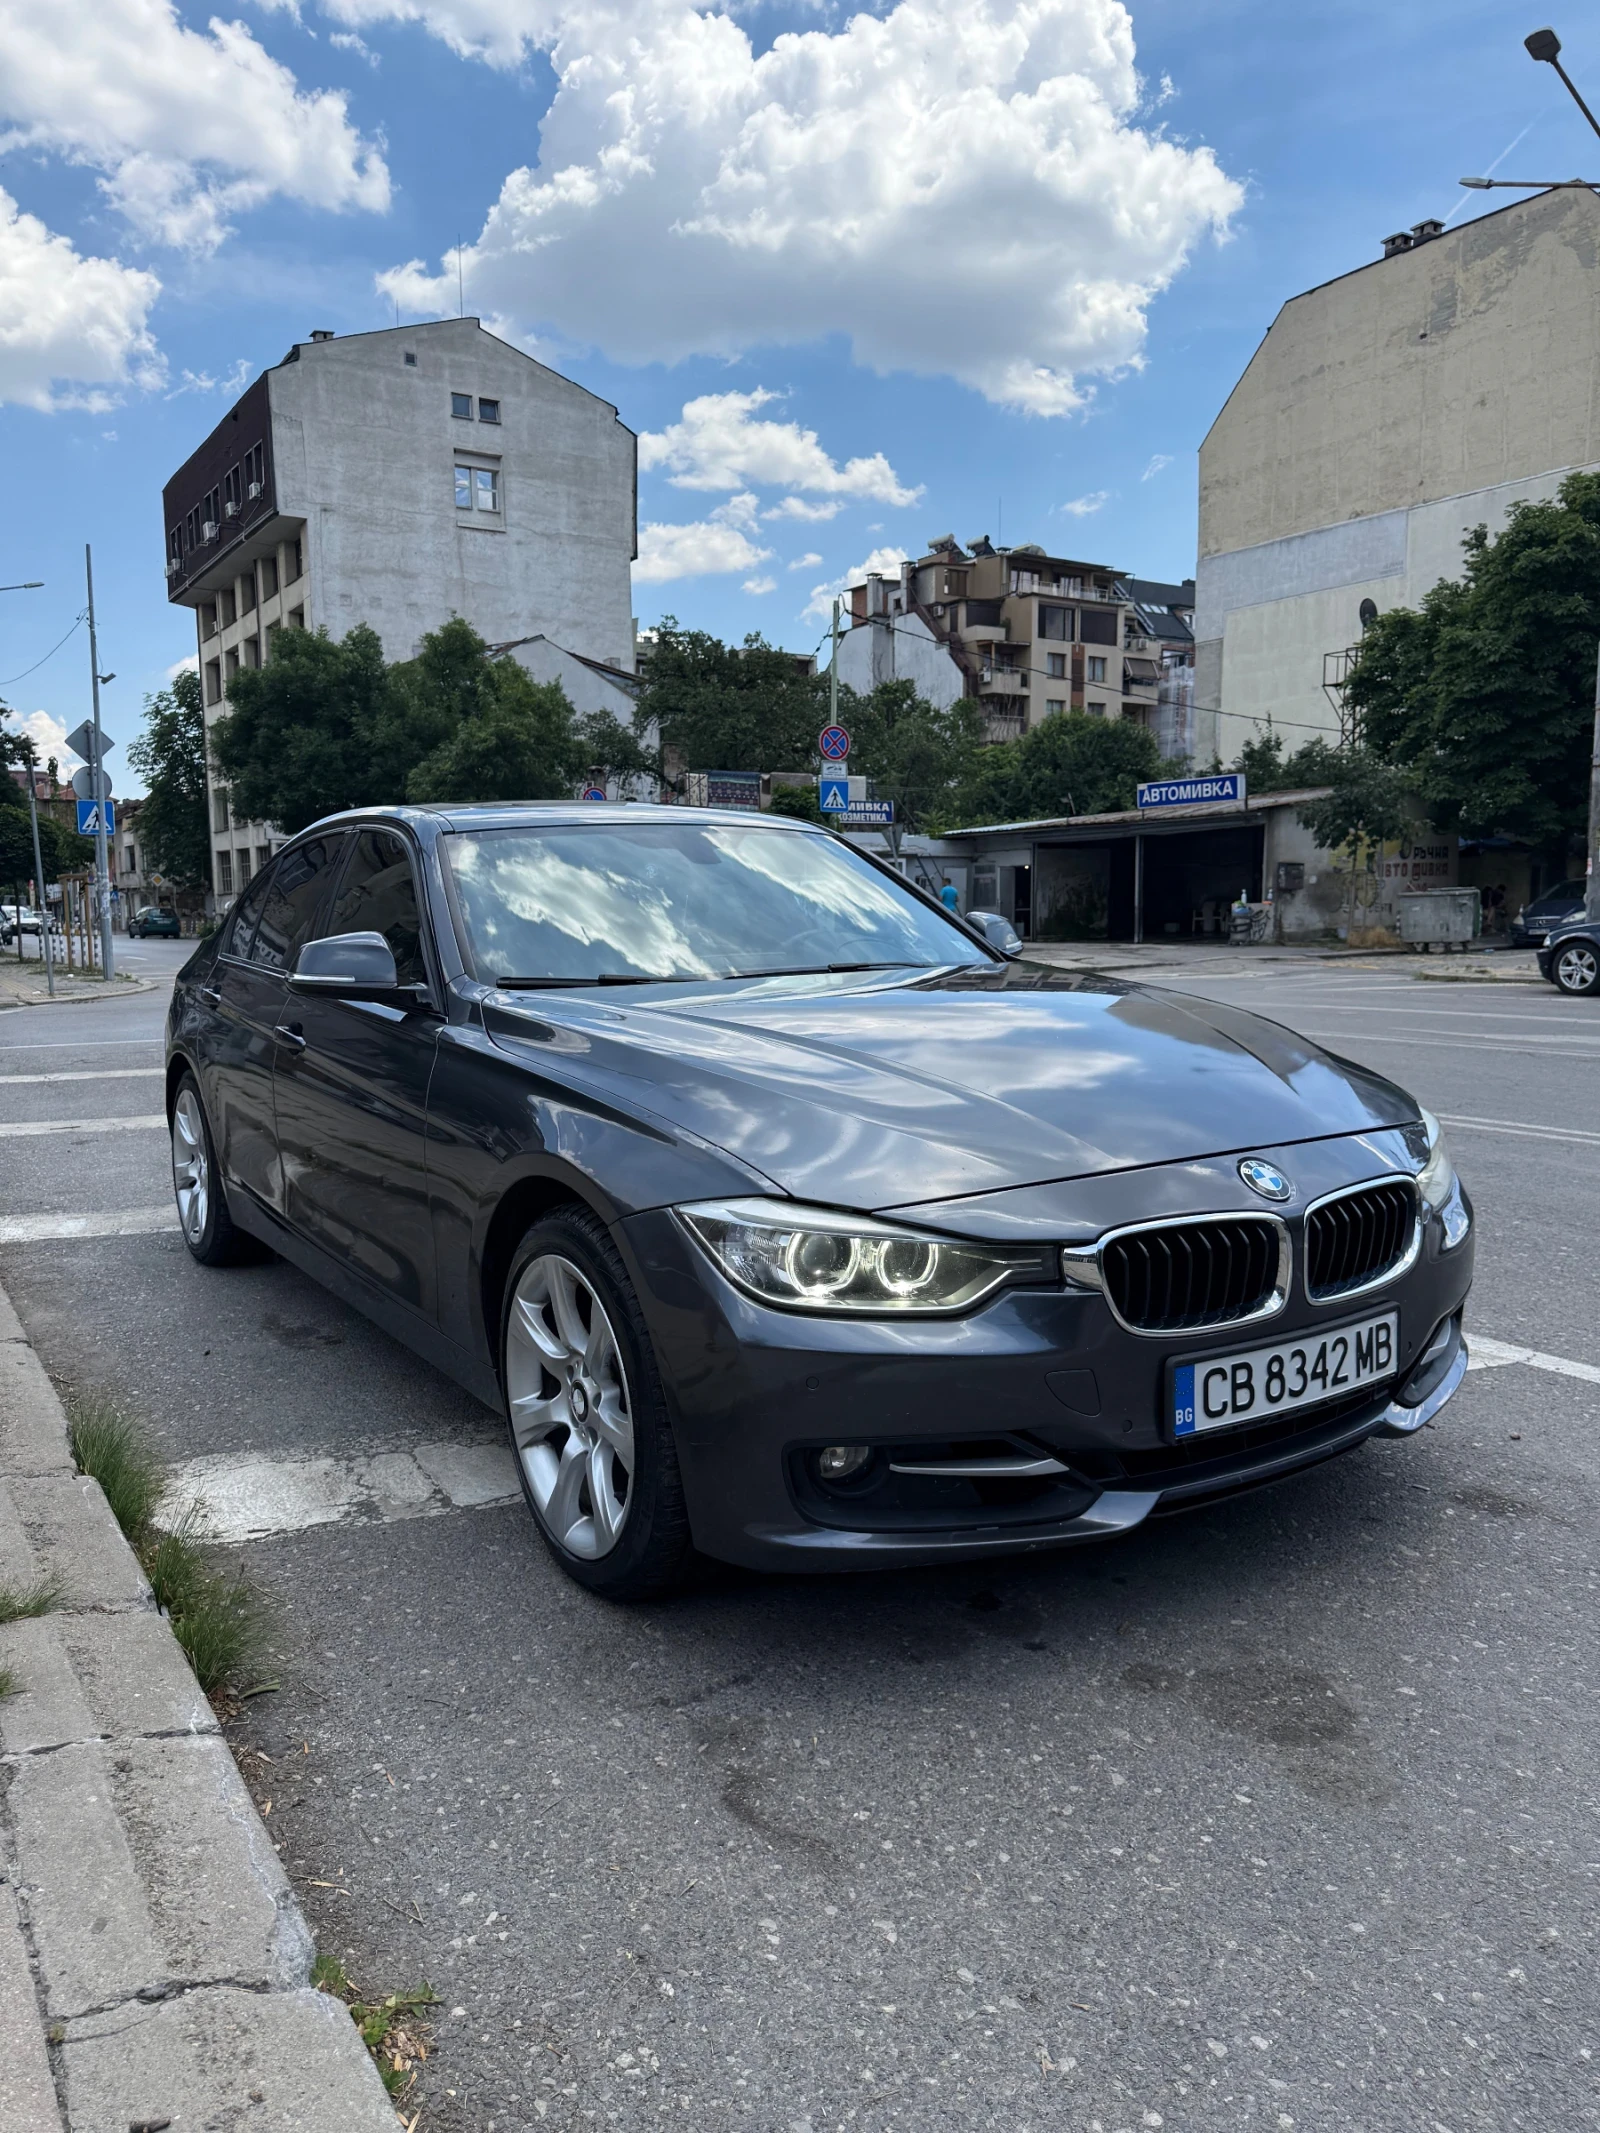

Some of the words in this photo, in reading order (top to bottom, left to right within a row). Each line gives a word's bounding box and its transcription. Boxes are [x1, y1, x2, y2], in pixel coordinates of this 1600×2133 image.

[1142, 780, 1233, 804] АВТОМИВКА
[1203, 1361, 1255, 1418] CB
[1265, 1336, 1349, 1403] 8342
[1356, 1322, 1392, 1378] MB
[1175, 1408, 1193, 1425] BG
